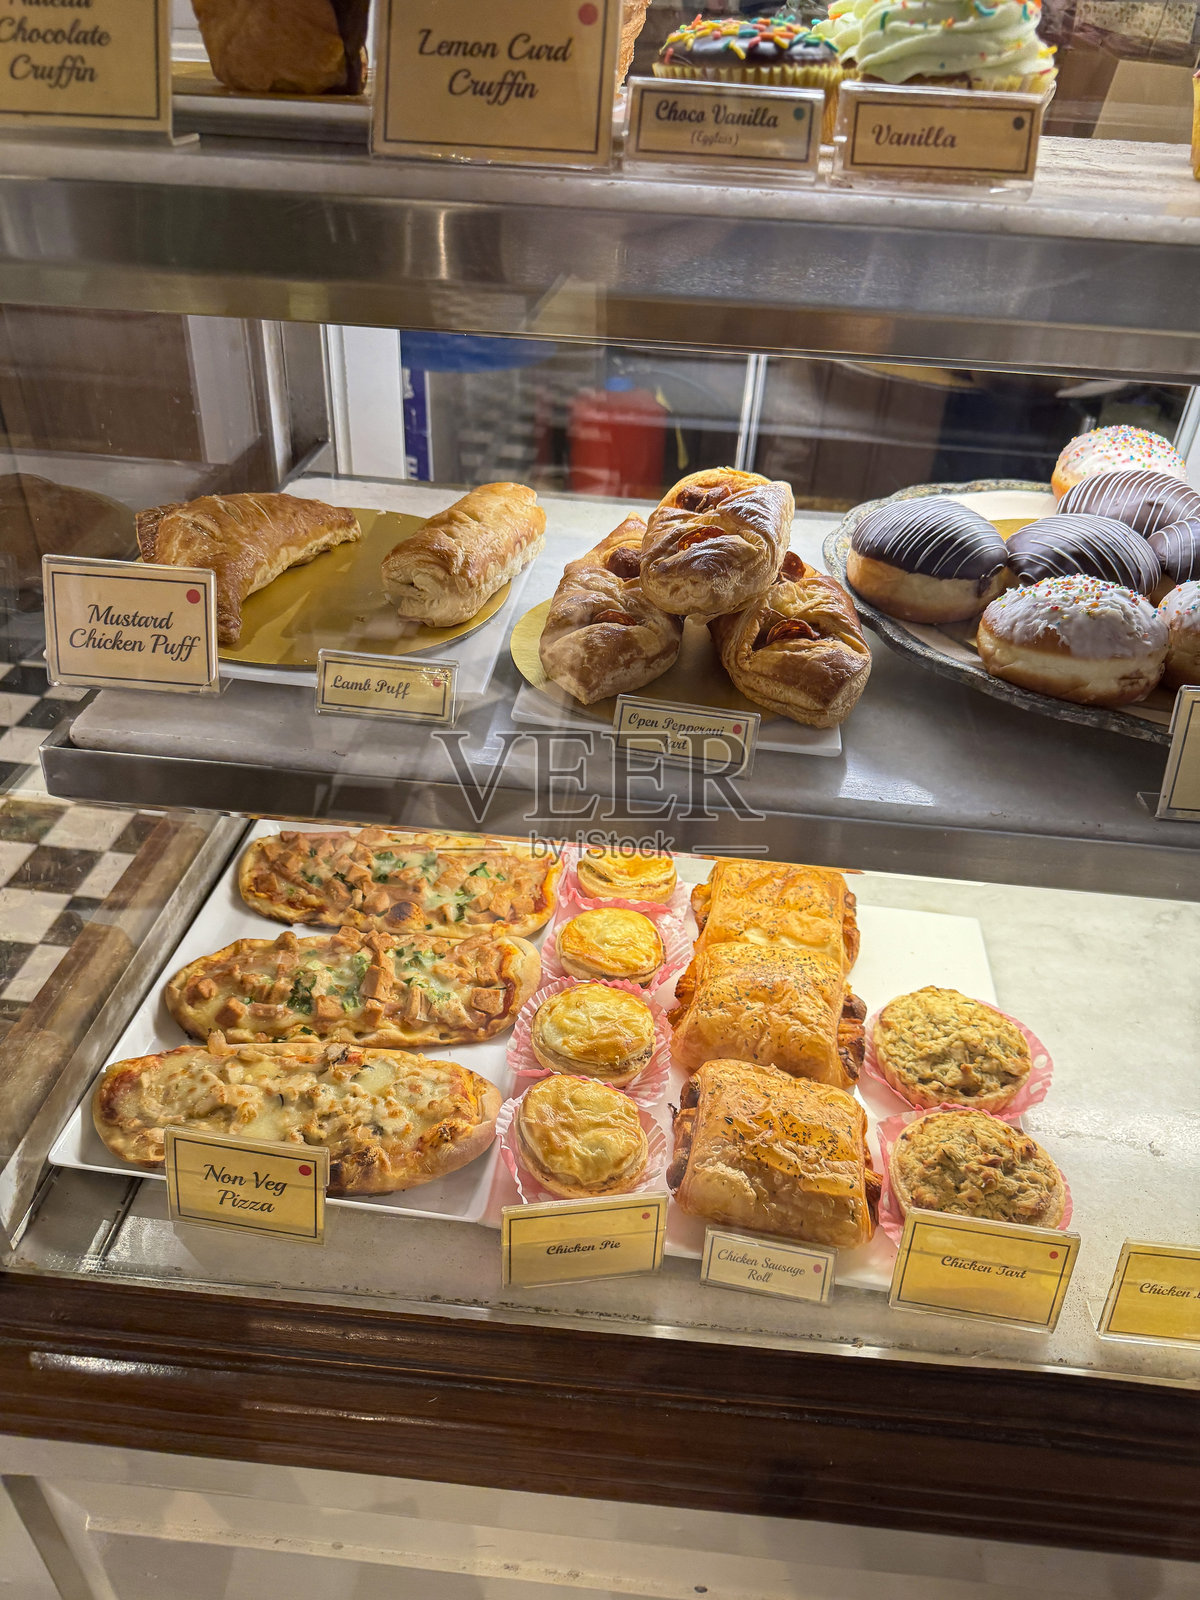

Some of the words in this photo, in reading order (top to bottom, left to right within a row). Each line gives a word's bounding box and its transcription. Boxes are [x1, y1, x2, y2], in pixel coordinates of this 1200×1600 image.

[0, 16, 111, 46] Chocolate
[418, 28, 499, 60] Lemon
[507, 33, 574, 63] Curd
[9, 54, 97, 89] Cruffin
[448, 69, 538, 106] Cruffin
[655, 100, 705, 123] Choco
[712, 104, 778, 128] Vanilla
[872, 124, 958, 149] Vanilla
[87, 604, 174, 630] Mustard
[69, 628, 145, 652] Chicken
[150, 634, 201, 662] Puff
[330, 675, 371, 691] Lamb
[375, 680, 411, 699] Puff
[628, 712, 659, 729] Open
[203, 1164, 246, 1186] Non
[252, 1171, 288, 1196] Veg
[217, 1189, 275, 1213] Pizza
[546, 1242, 596, 1255] Chicken
[599, 1239, 621, 1250] Pie
[717, 1249, 759, 1266] Chicken
[761, 1257, 805, 1277] Sausage
[747, 1268, 773, 1283] Roll
[941, 1255, 993, 1274] Chicken
[995, 1265, 1027, 1279] Tart
[1139, 1282, 1191, 1298] Chicken
